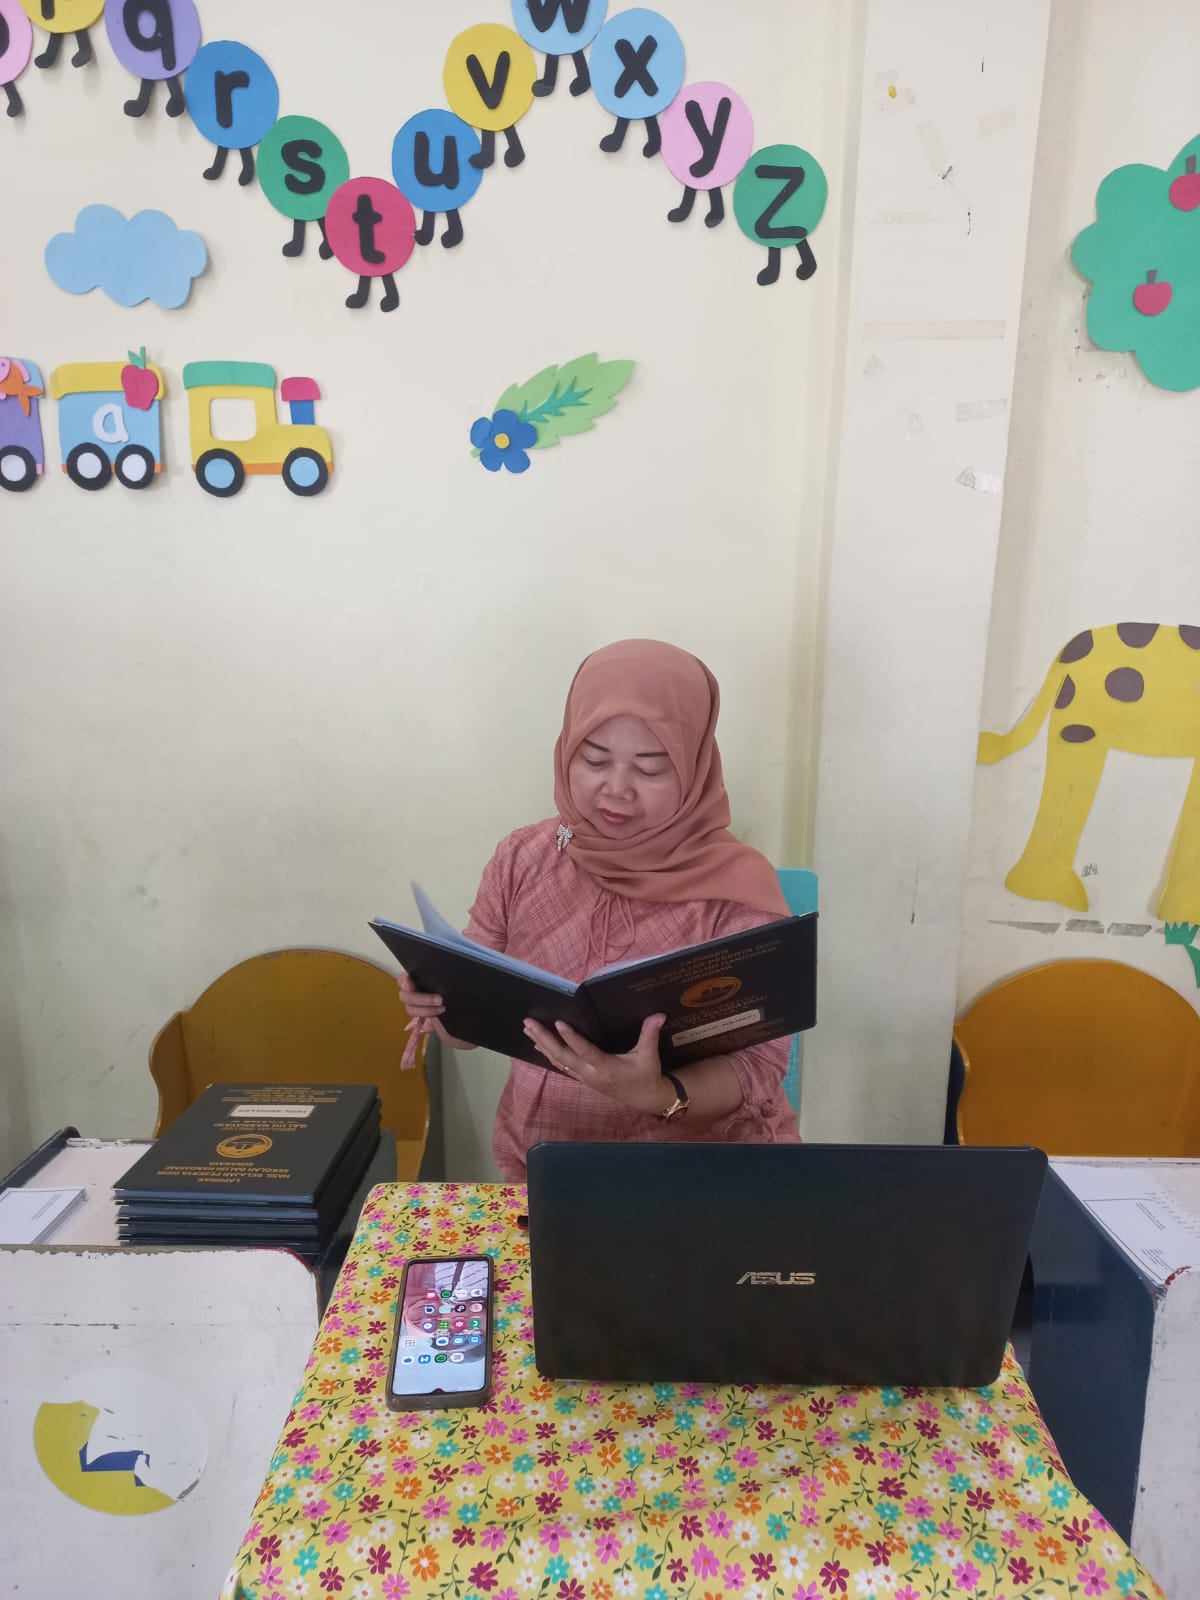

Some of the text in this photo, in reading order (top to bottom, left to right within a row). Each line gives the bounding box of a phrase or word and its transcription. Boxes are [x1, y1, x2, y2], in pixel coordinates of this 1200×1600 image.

[123, 0, 176, 71] q
[466, 50, 510, 109] v
[614, 35, 658, 98] x
[214, 70, 250, 128] r
[281, 139, 326, 194] s
[414, 131, 459, 190] u
[684, 97, 731, 178] y
[352, 194, 387, 264] t
[92, 403, 129, 443] a
[736, 1271, 816, 1285] ASUS
